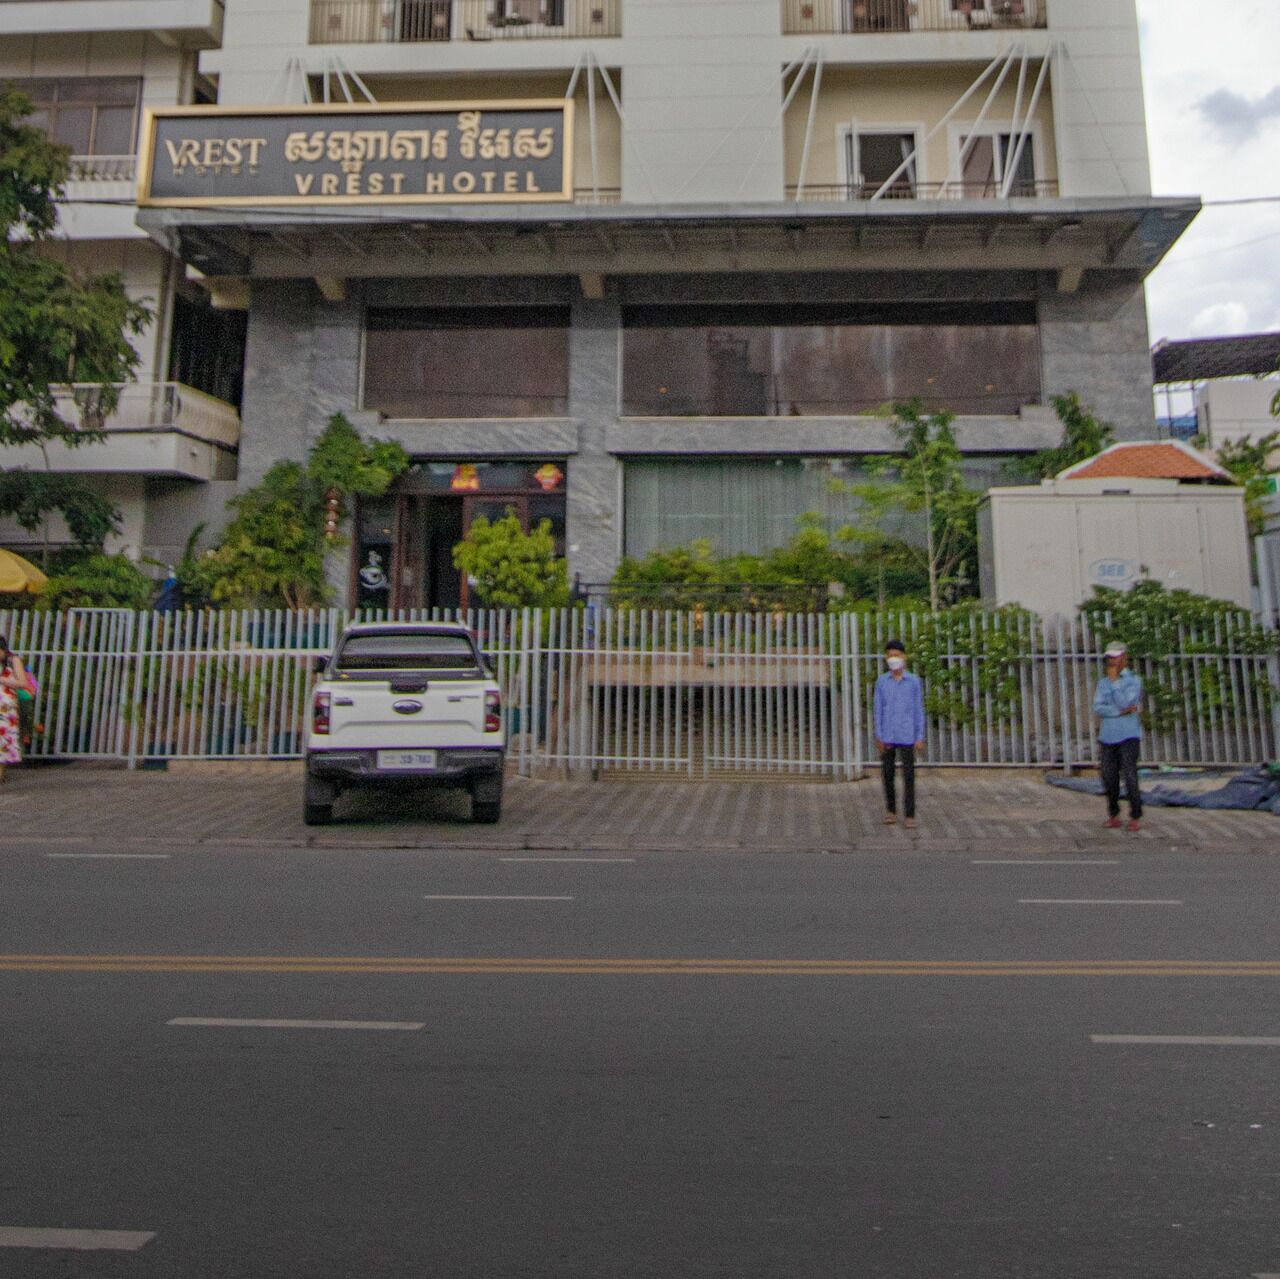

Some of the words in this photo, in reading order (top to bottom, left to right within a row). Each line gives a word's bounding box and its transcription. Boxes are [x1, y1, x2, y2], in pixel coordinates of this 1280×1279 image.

[165, 137, 267, 167] VREST
[294, 173, 405, 195] VREST
[426, 171, 540, 194] HOTEL
